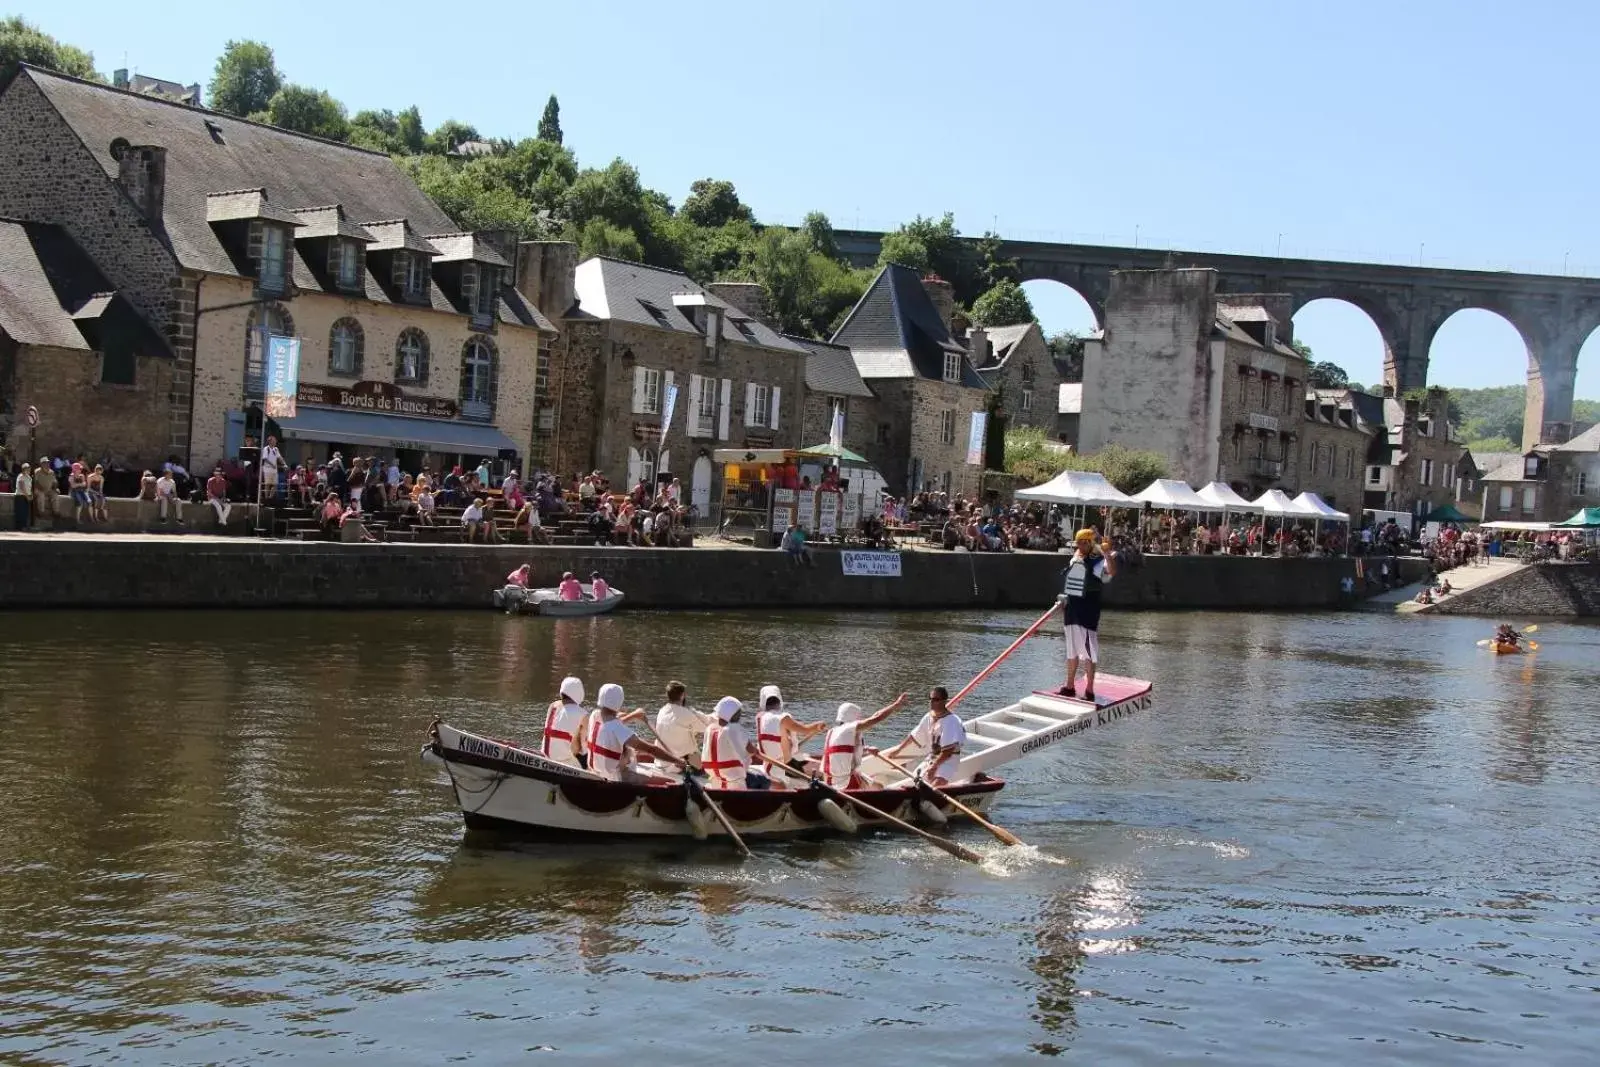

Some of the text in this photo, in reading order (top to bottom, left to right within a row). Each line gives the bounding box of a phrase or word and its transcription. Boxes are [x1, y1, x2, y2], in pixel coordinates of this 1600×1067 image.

[340, 391, 375, 408] Bords
[377, 396, 391, 410] de
[393, 397, 429, 413] Rance
[1096, 694, 1152, 726] KIWANIS
[459, 735, 500, 758] KIWANIS
[503, 749, 540, 768] VANNES
[1021, 717, 1092, 754] GRAND FOUGERAY
